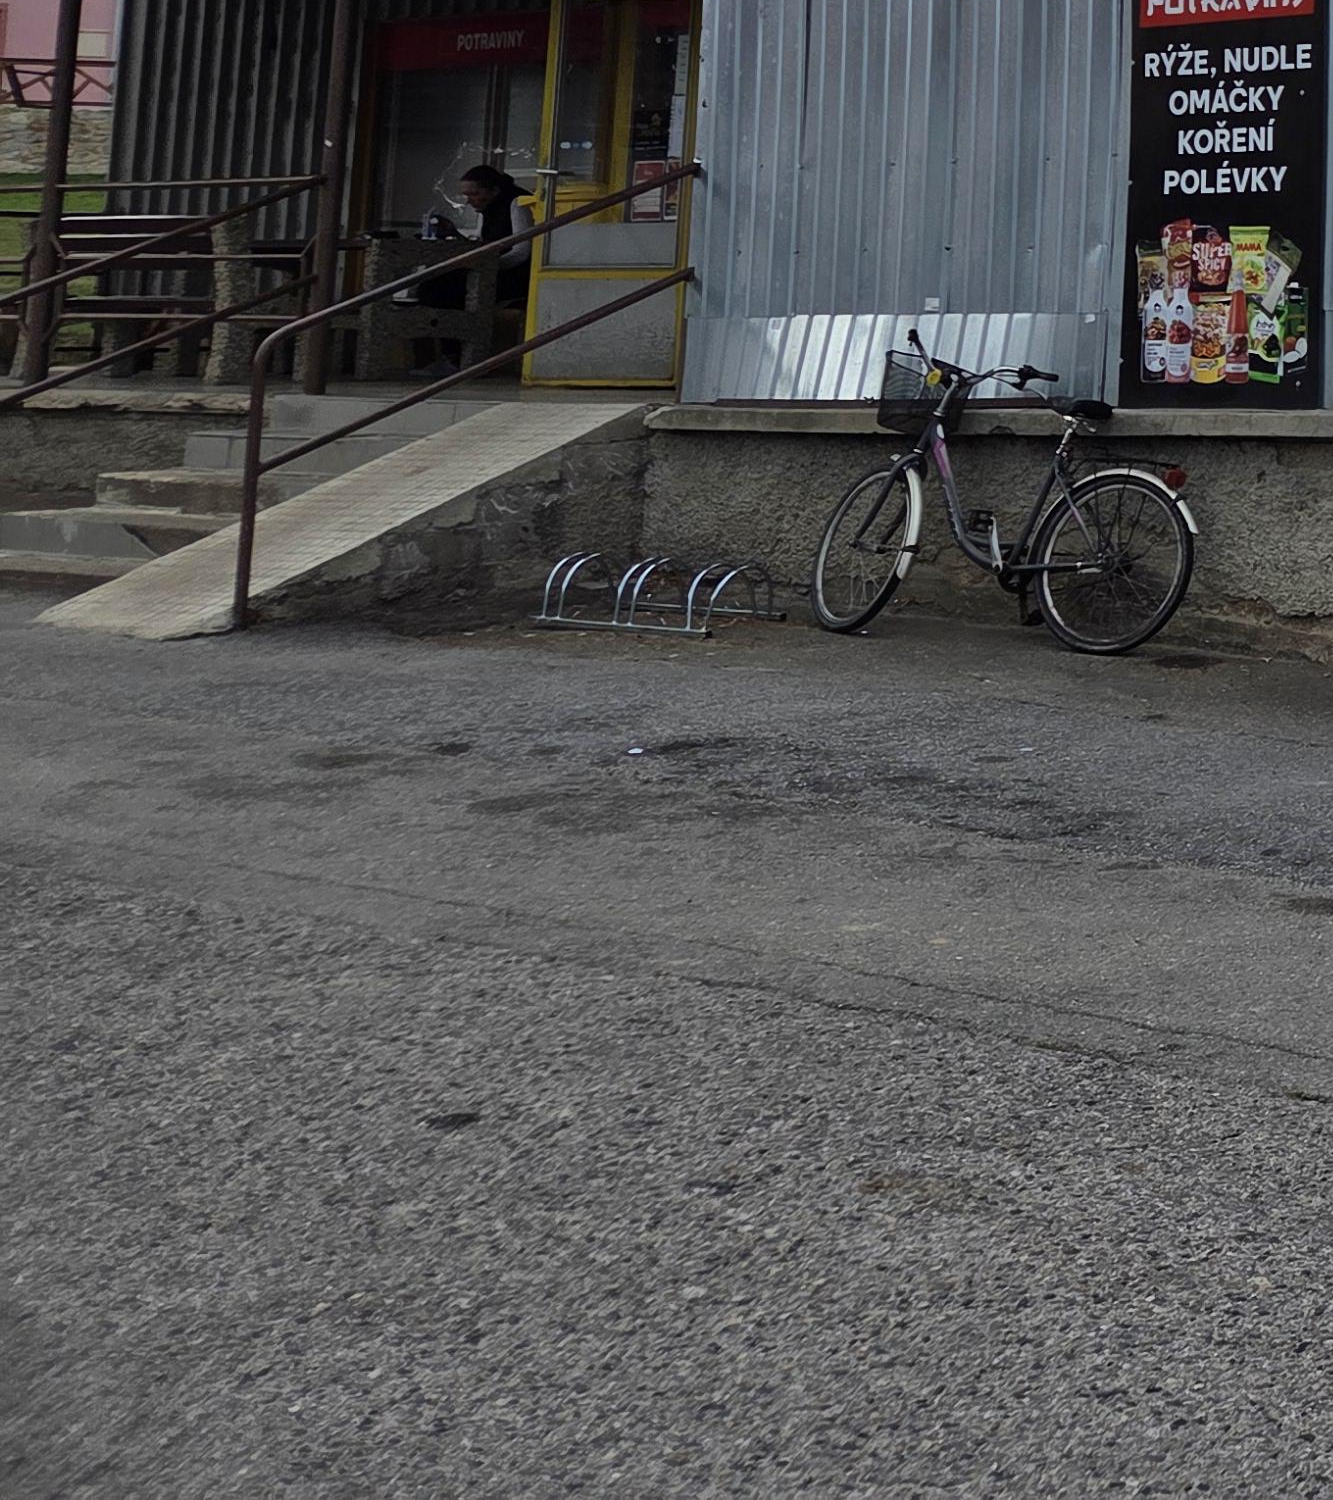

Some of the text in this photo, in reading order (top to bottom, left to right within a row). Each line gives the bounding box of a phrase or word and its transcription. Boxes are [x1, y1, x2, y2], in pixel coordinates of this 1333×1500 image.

[457, 30, 525, 51] POTRAVINY
[1144, 44, 1312, 80] RÝŽE, NUDLE
[1168, 78, 1285, 116] OMÁČKY
[1177, 117, 1275, 156] KOŘENÍ
[1163, 159, 1288, 196] POLÉVKY
[1192, 242, 1232, 260] SUPER
[1197, 257, 1227, 271] SPICY
